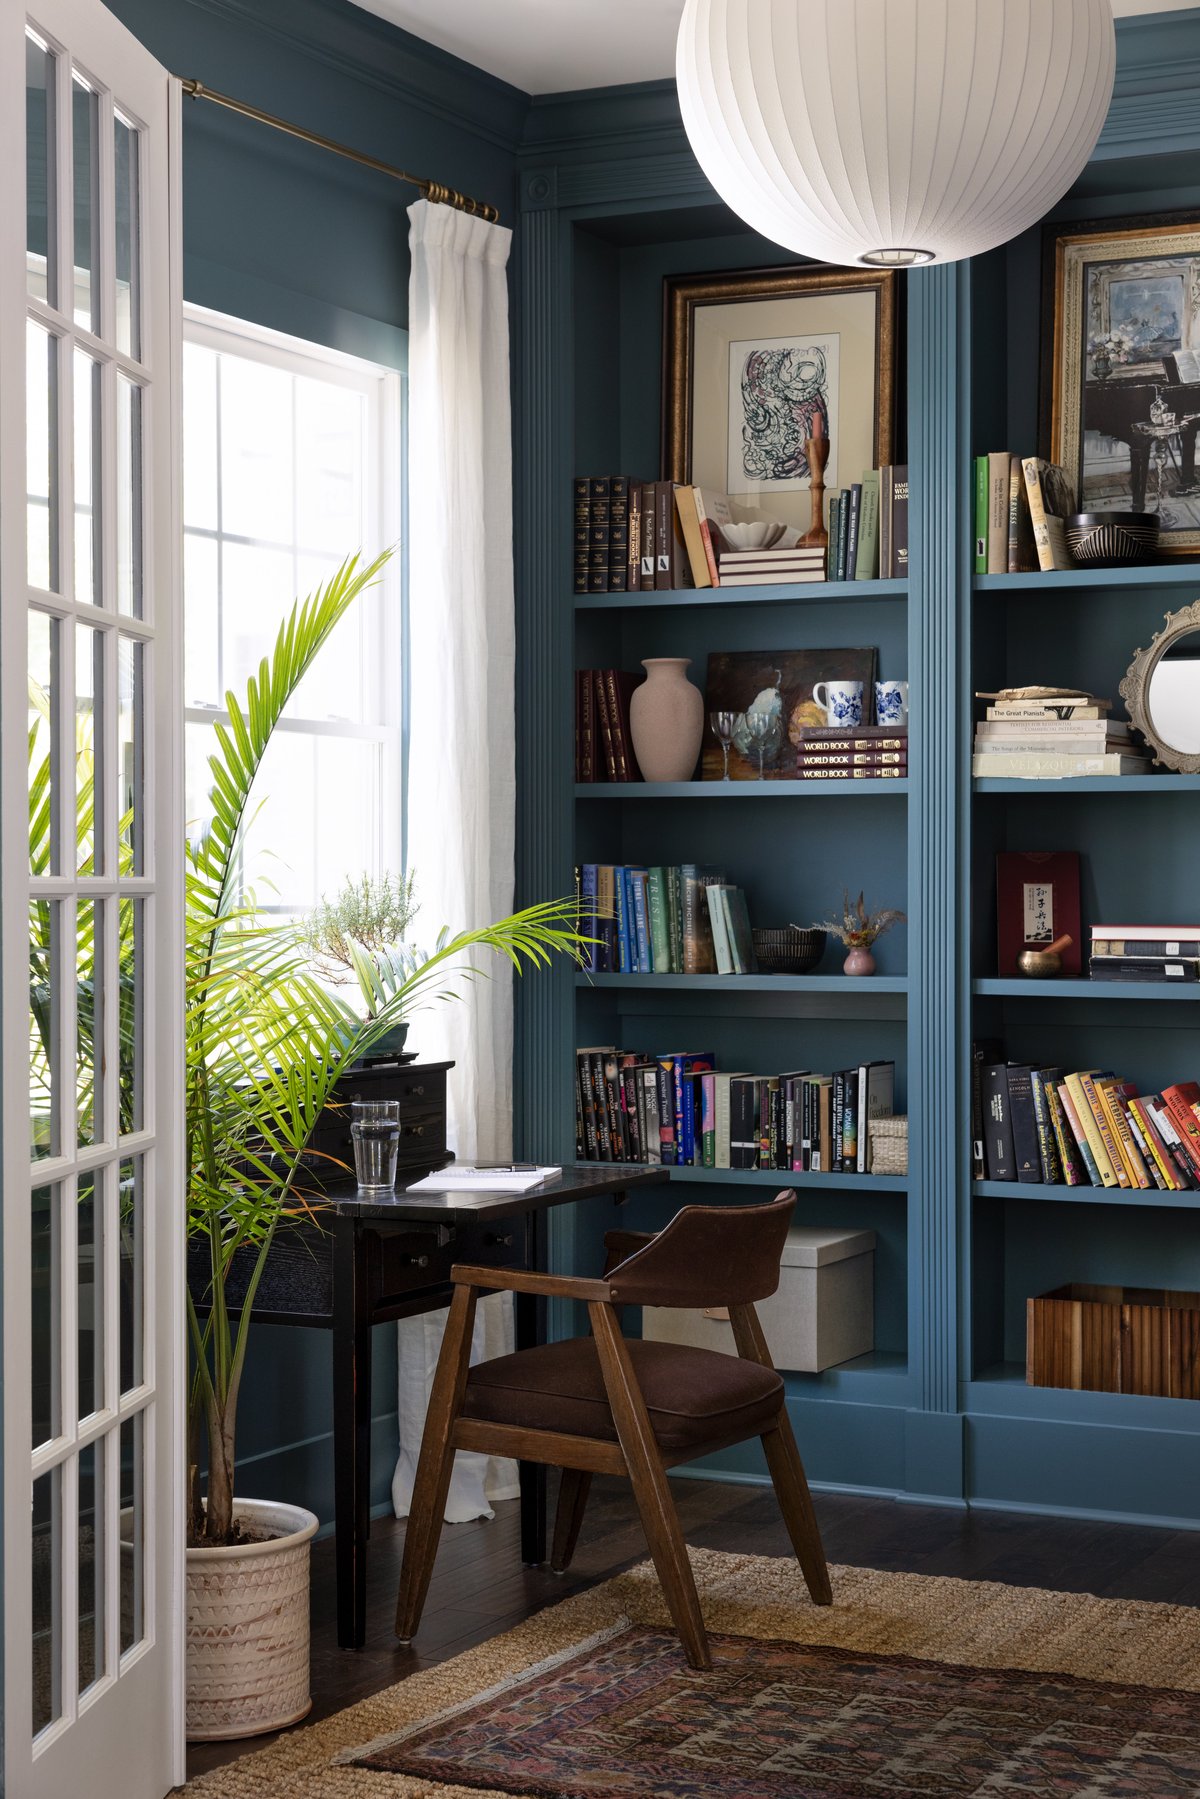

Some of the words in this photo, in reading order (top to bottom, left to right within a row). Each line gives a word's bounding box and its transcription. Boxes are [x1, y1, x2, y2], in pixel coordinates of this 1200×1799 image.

[1009, 477, 1018, 524] WILDERNESS
[595, 676, 606, 704] WORLD
[607, 676, 616, 703] WORLD
[600, 704, 609, 723] BOOK
[650, 875, 660, 926] TRUST
[628, 1078, 636, 1103] DIFFICULT
[1084, 1080, 1098, 1105] MEMPHIS
[607, 1083, 616, 1130] CARTOGRAPHERS
[1105, 1090, 1131, 1143] AFTERPARTIES
[1167, 1096, 1185, 1122] WOUNDS
[1172, 1093, 1182, 1104] THE
[1180, 1105, 1190, 1118] FIVE
[1095, 1111, 1105, 1125] TARA
[1103, 1133, 1123, 1173] STRINGFELLOW
